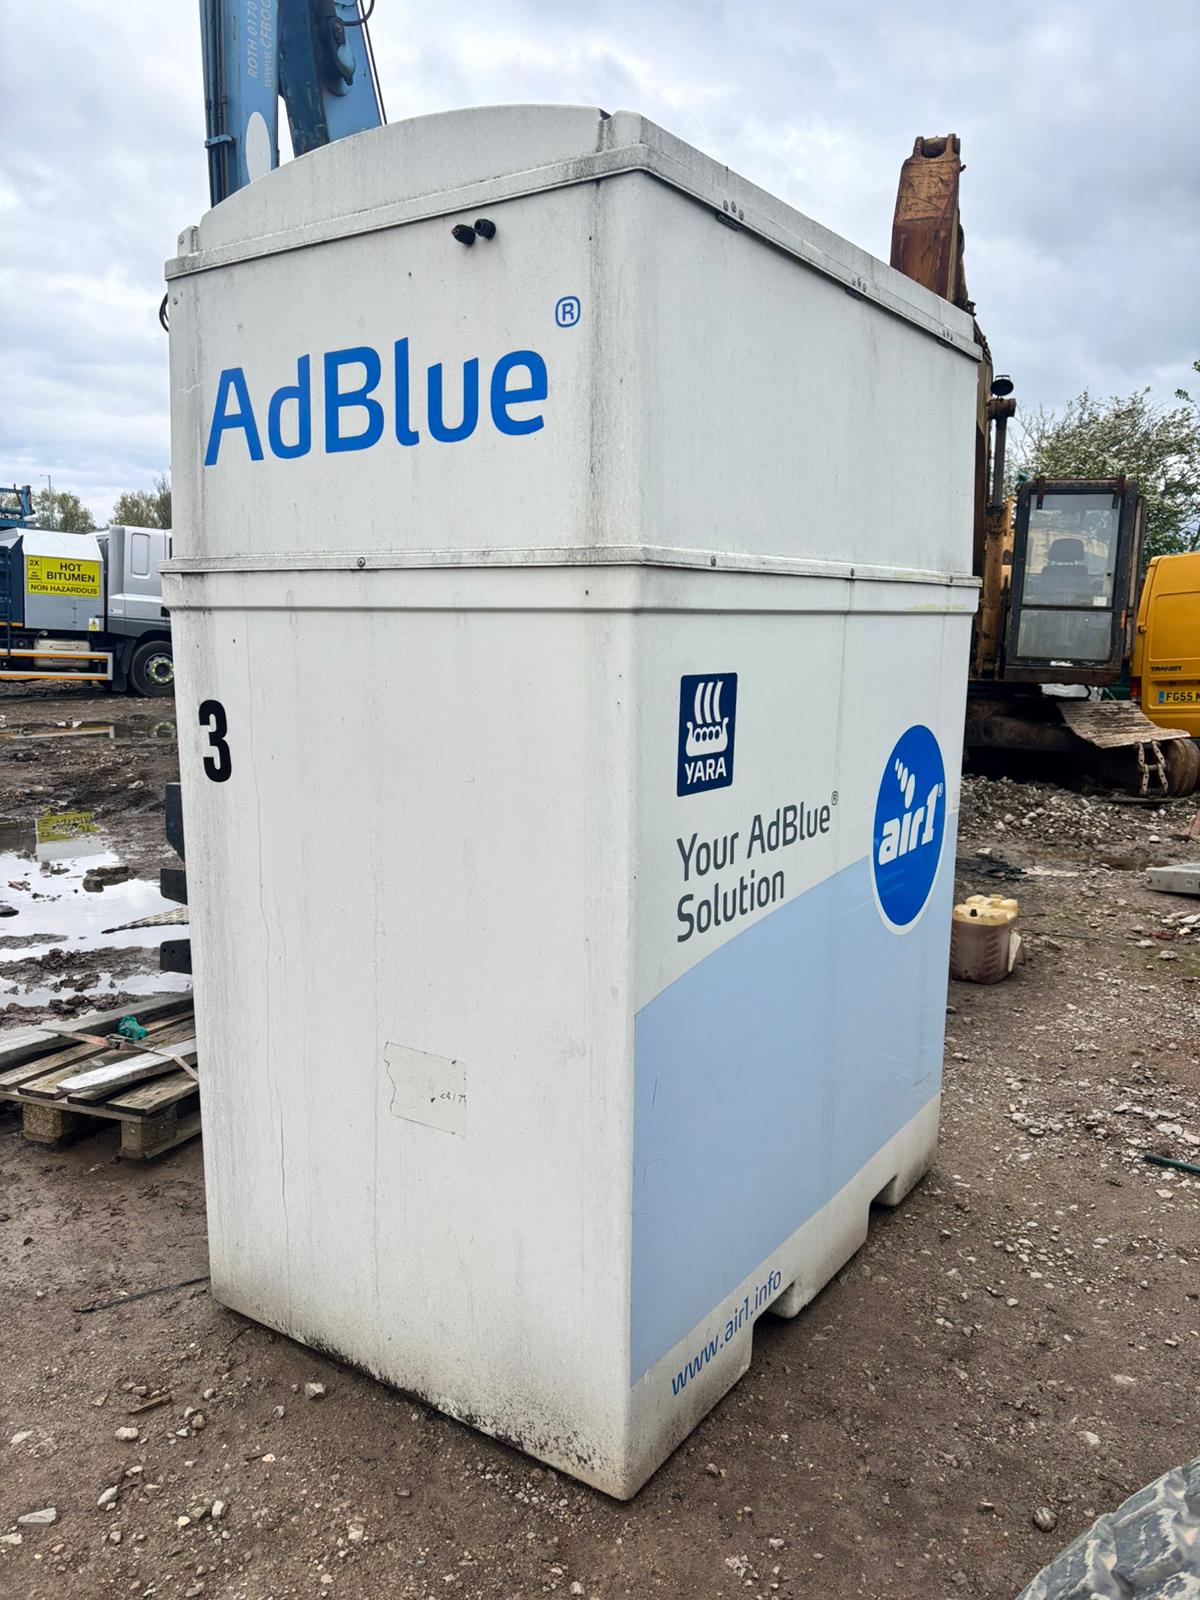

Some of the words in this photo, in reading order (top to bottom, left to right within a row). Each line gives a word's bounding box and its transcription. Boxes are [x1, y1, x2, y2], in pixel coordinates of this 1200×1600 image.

[46, 571, 95, 582] BITUMEN
[60, 563, 82, 572] HOT
[50, 585, 97, 594] HAZARDOUS
[198, 699, 232, 783] 3
[684, 756, 727, 785] YARA
[676, 832, 739, 882] Your
[676, 868, 785, 943] Solution
[671, 1270, 782, 1396] www.air1.info
